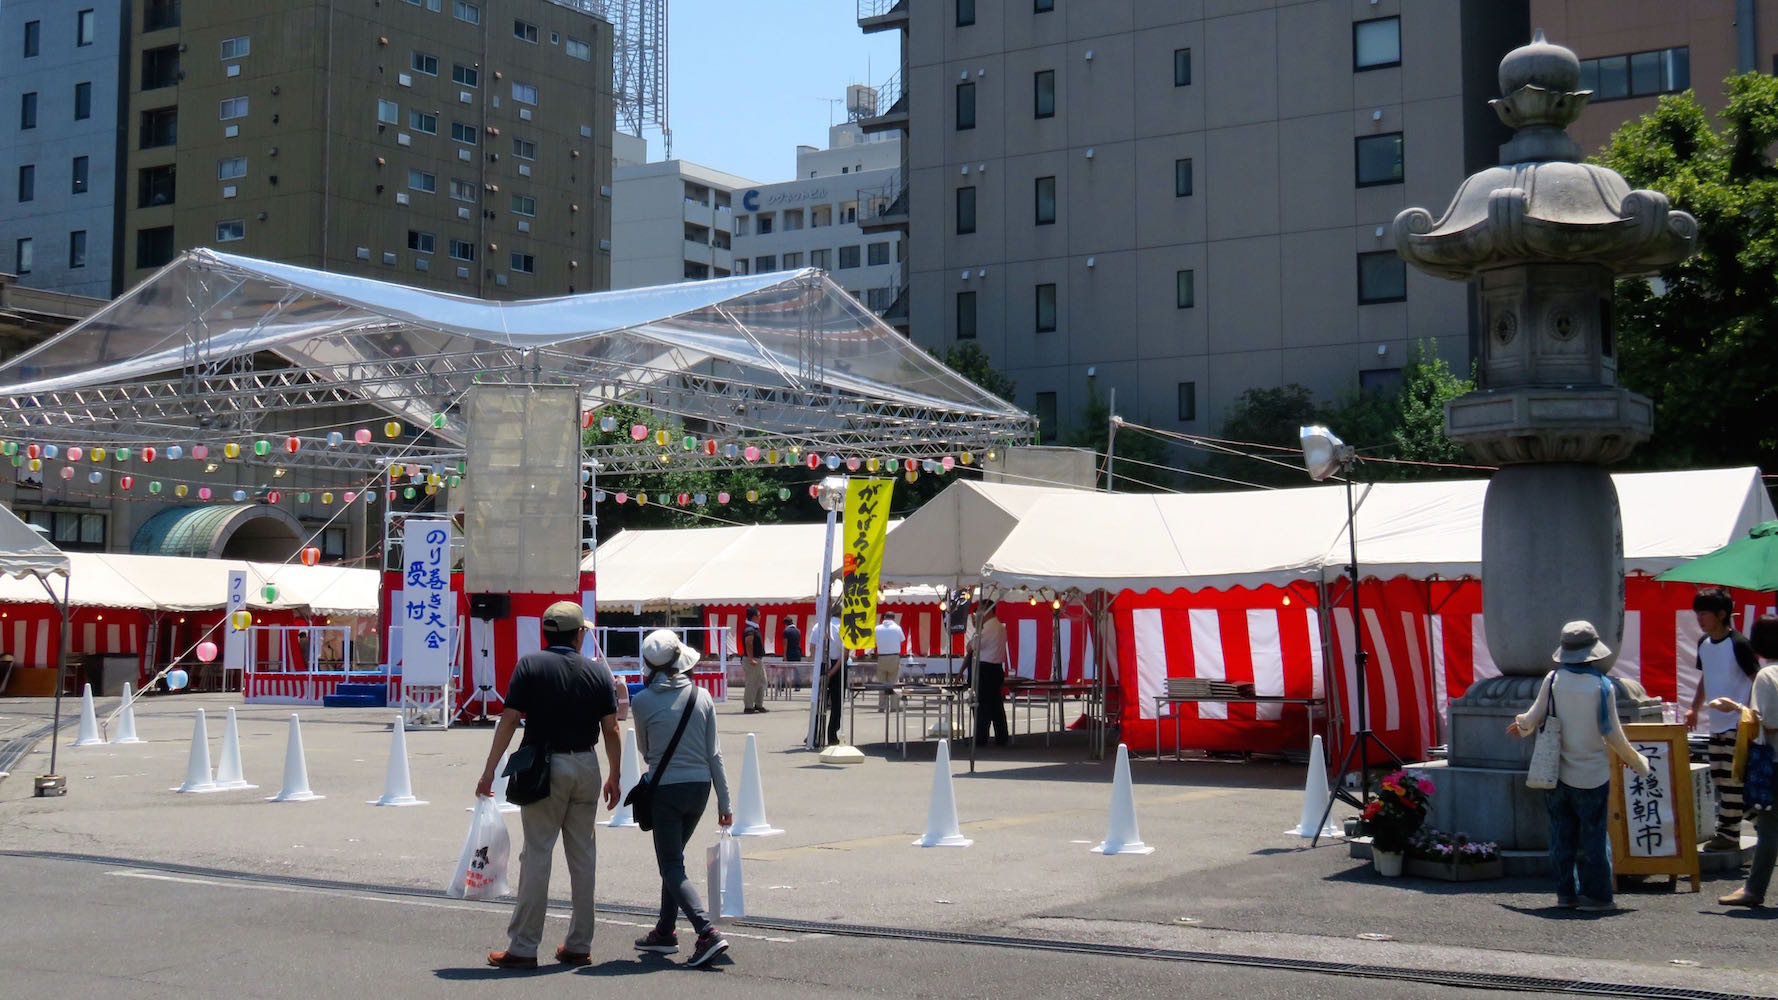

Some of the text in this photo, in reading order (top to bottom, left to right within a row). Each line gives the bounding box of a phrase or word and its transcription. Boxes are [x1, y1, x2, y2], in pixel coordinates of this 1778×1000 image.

[406, 561, 427, 620] 受付
[424, 529, 447, 649] のり巻き大会
[843, 484, 883, 645] がんばろう熊本
